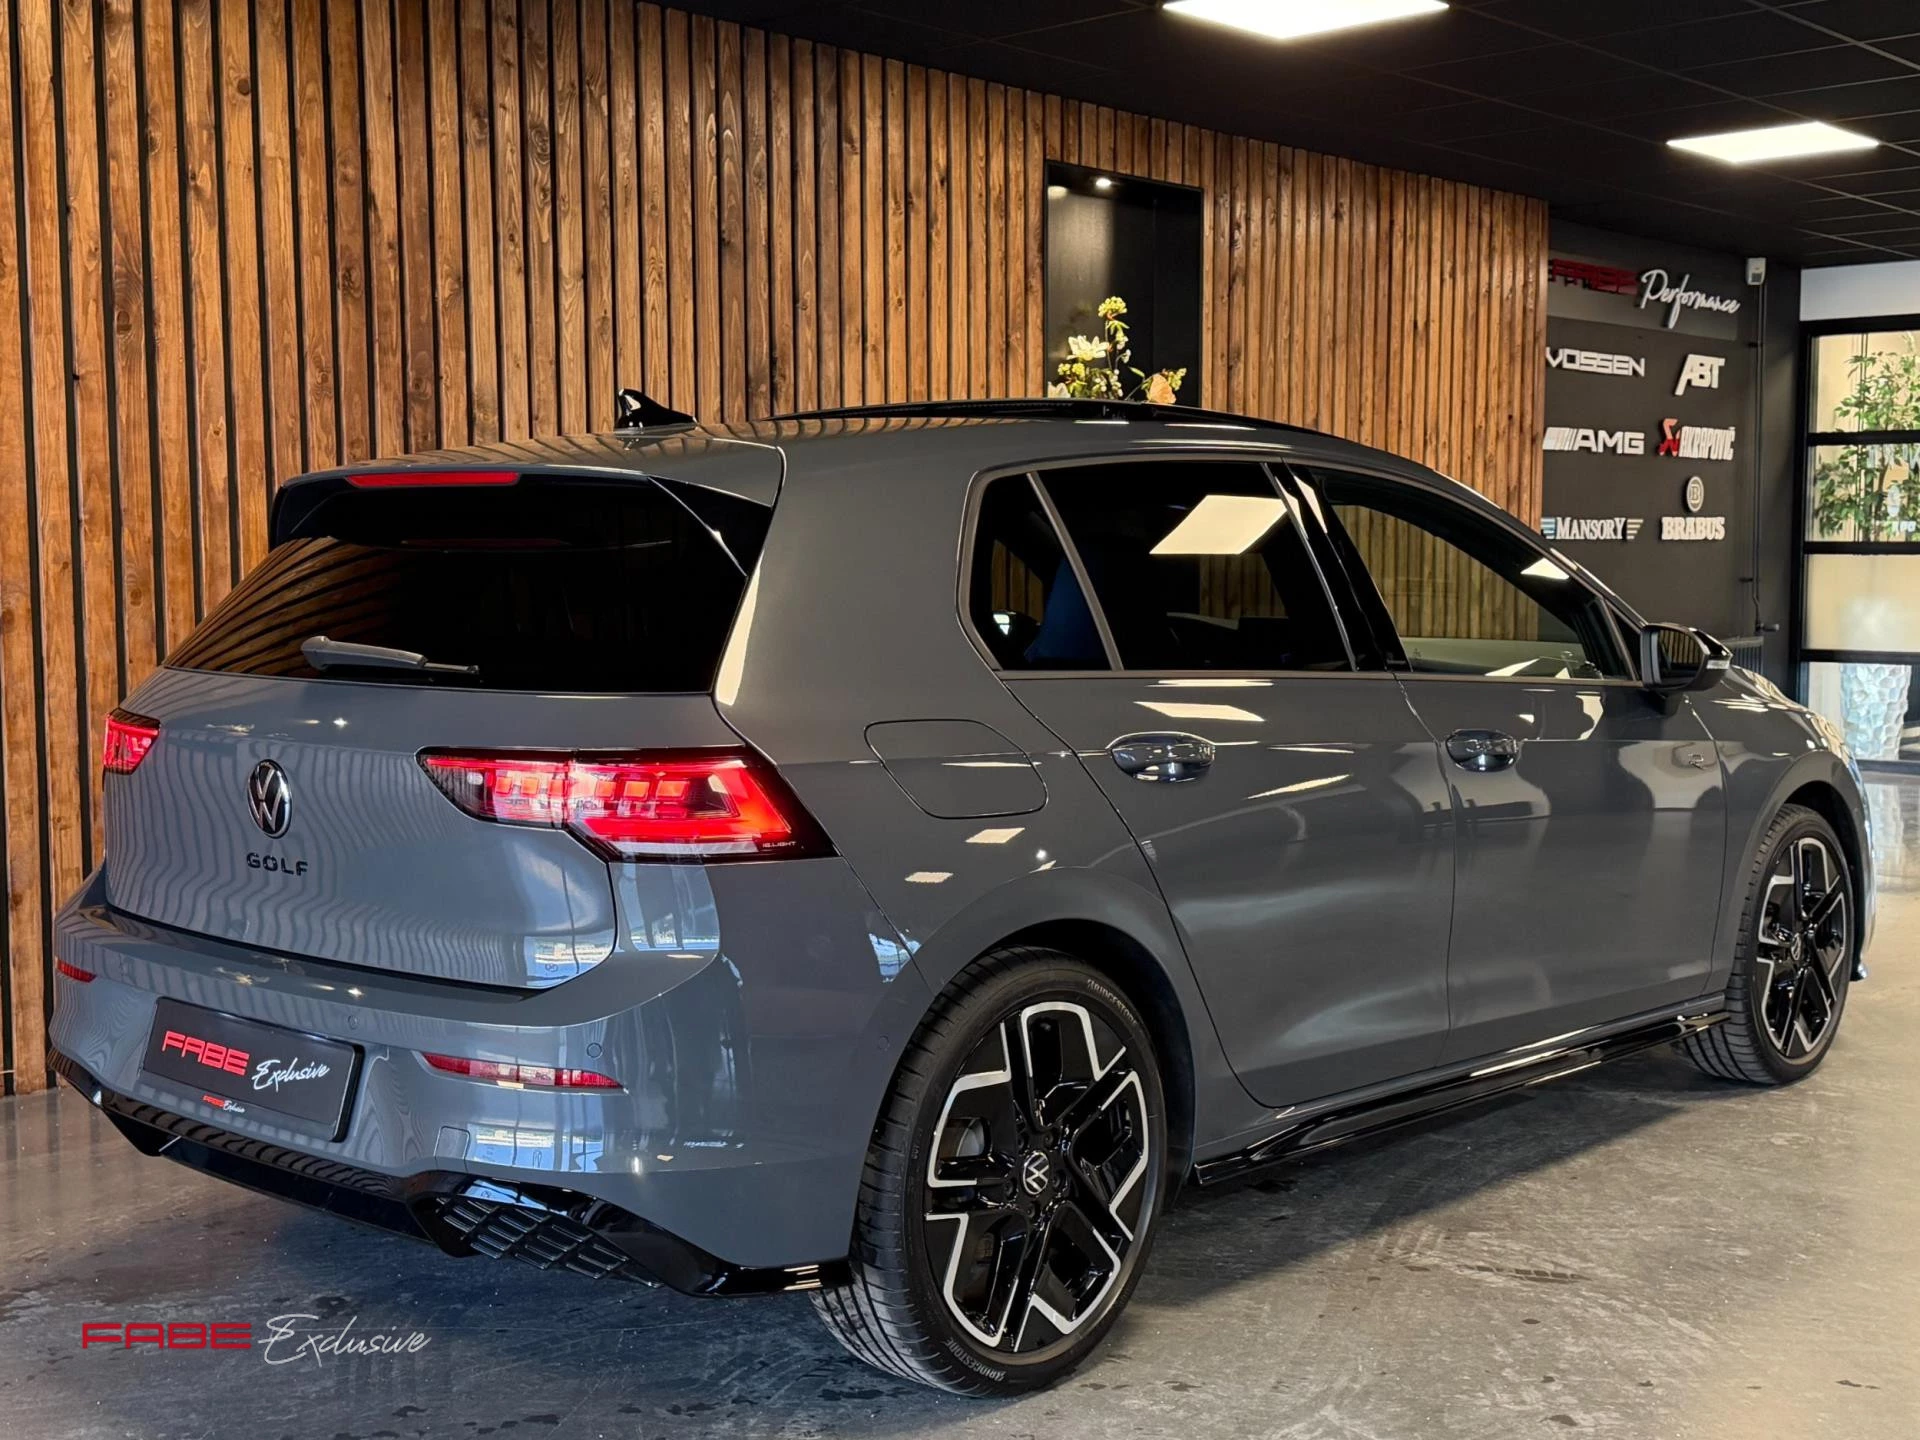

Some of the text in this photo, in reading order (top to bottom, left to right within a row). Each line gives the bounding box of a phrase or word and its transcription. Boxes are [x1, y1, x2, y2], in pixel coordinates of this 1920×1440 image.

[1641, 269, 1740, 329] Performance
[1546, 347, 1645, 377] VOSSEN
[1674, 353, 1726, 396] ABT
[1573, 428, 1645, 455] AMG
[1661, 516, 1726, 540] BRABUS
[246, 852, 308, 876] GOLF
[162, 1030, 330, 1092] FABE Exclusive
